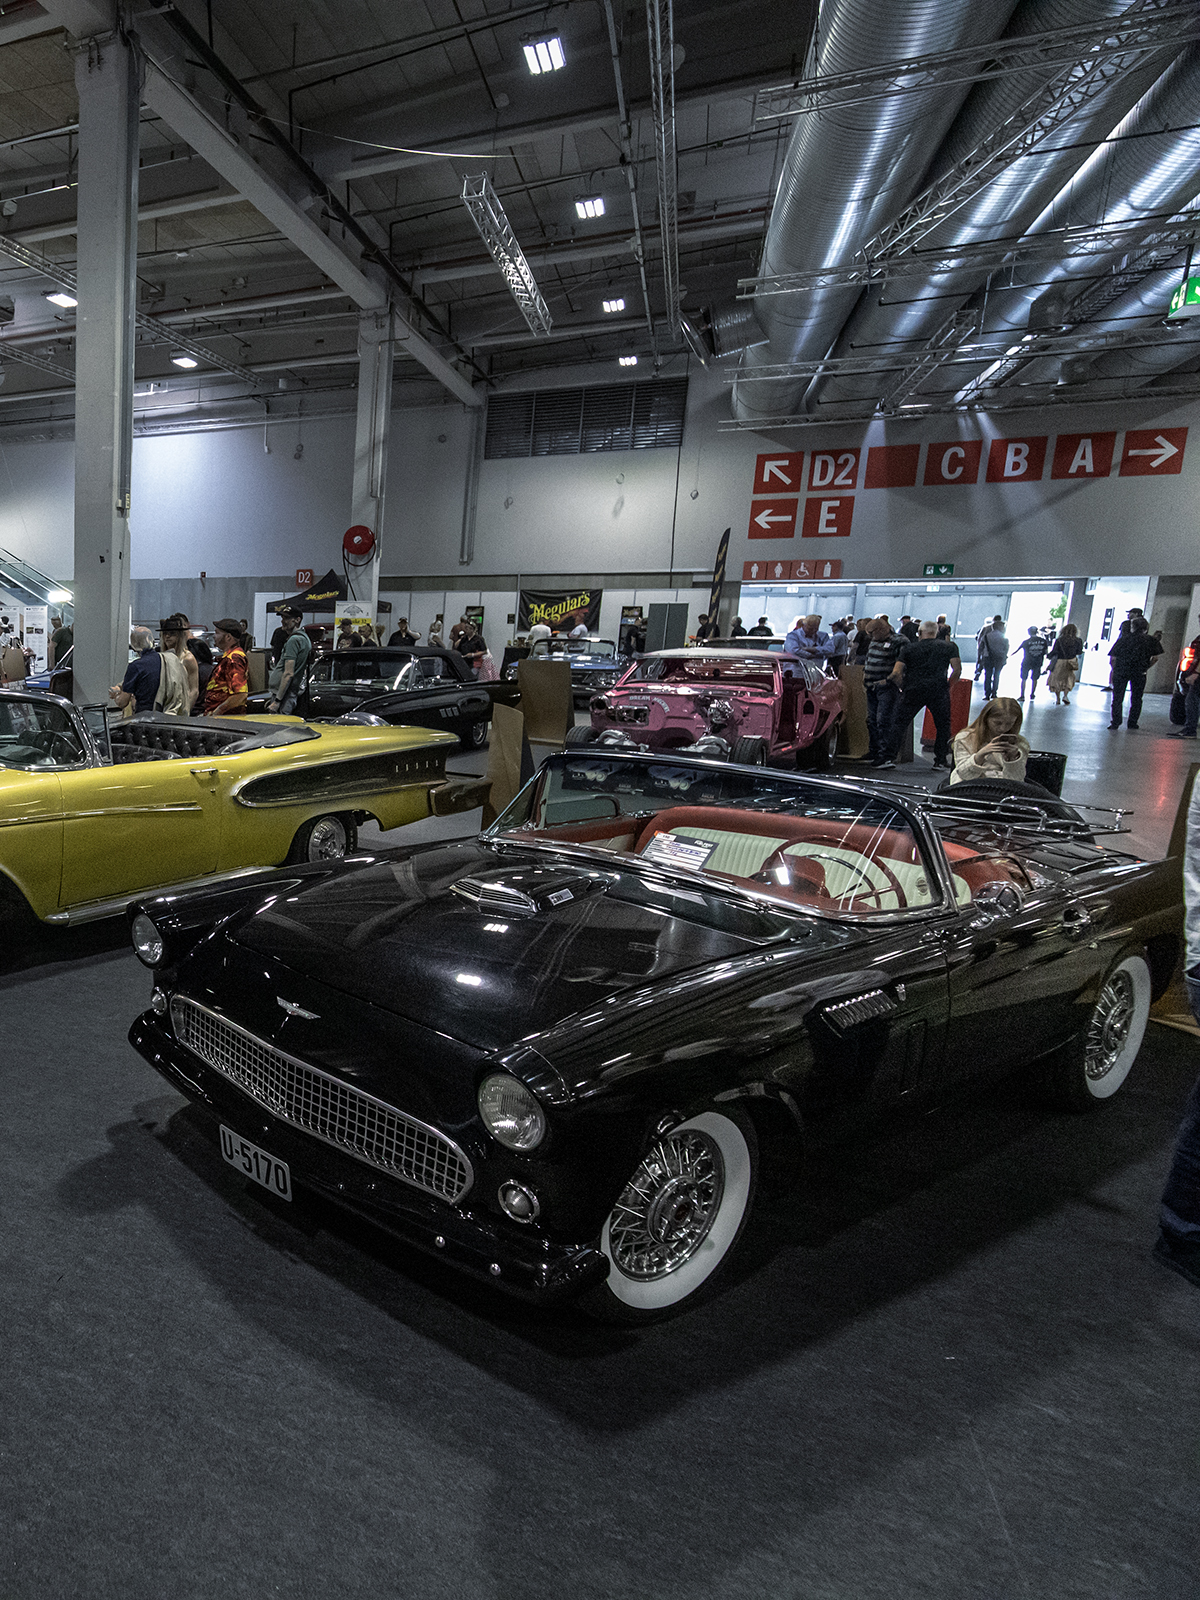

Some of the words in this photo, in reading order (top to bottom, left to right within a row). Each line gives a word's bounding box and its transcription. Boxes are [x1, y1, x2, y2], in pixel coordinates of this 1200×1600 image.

[811, 453, 856, 488] D2
[940, 446, 966, 480] C
[1003, 442, 1030, 477] B
[1068, 438, 1094, 474] A
[818, 500, 841, 534] E
[298, 571, 311, 584] D2
[527, 591, 591, 625] Meguiar's
[222, 1126, 289, 1196] U-5170
